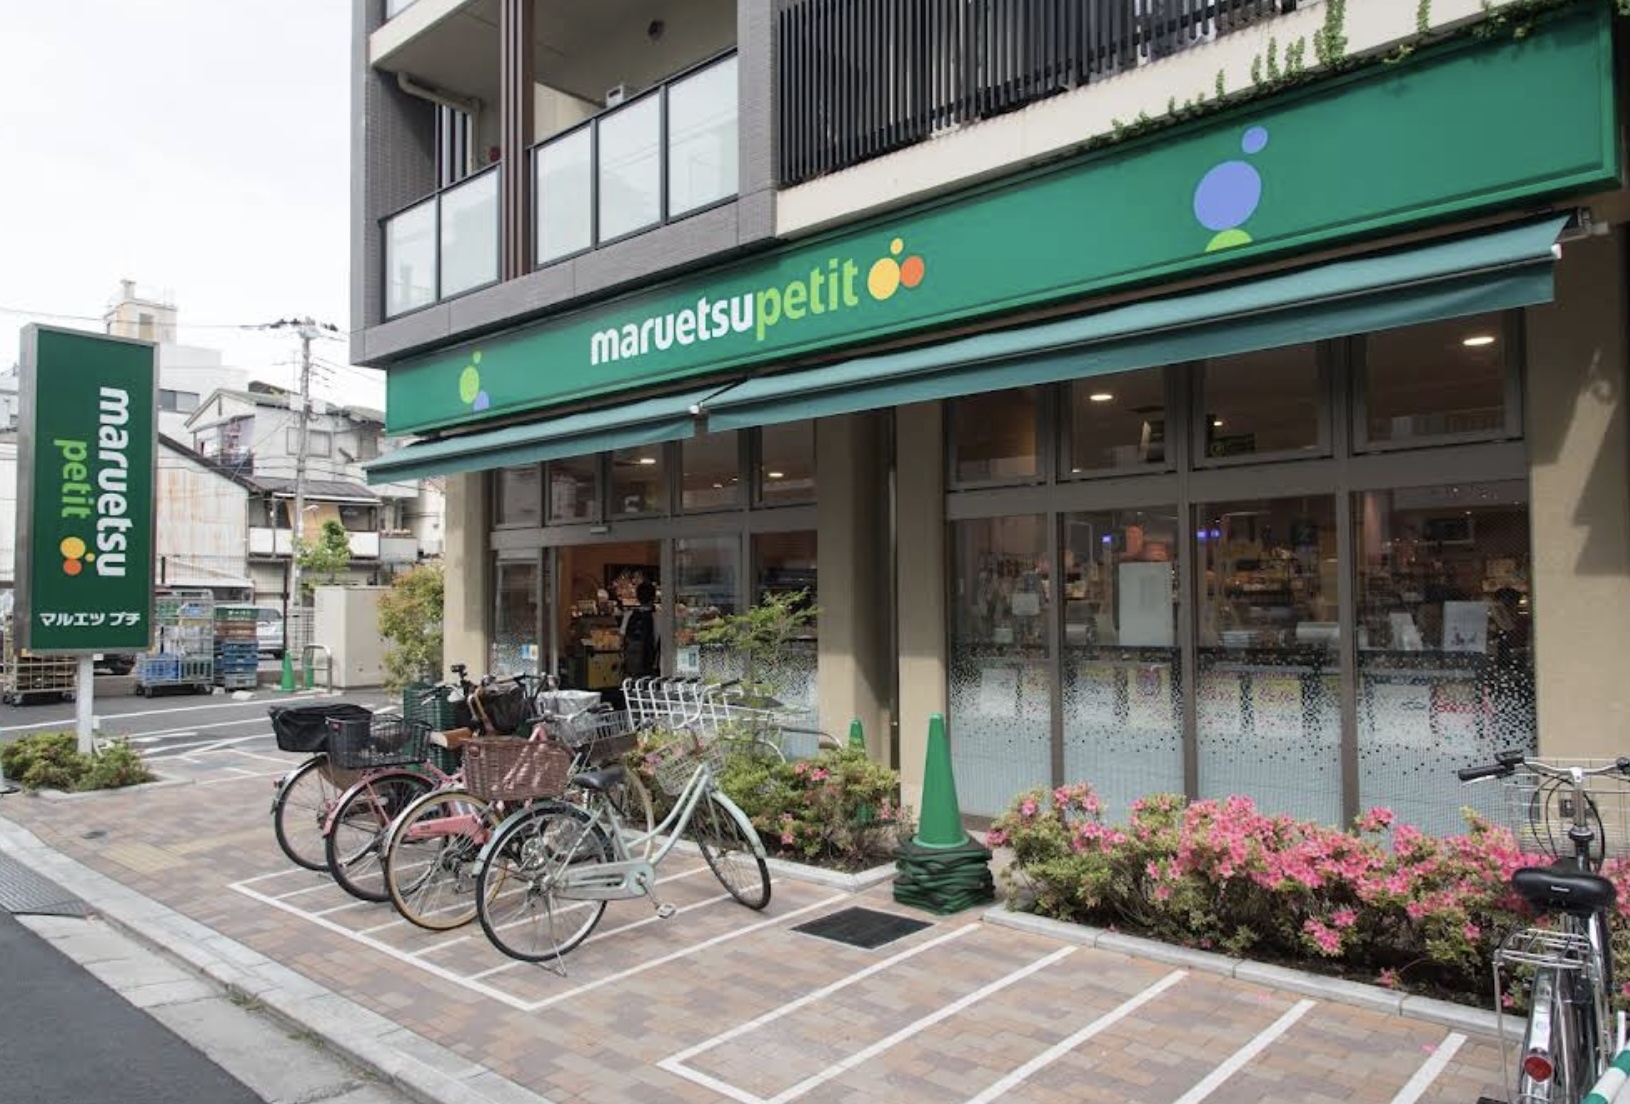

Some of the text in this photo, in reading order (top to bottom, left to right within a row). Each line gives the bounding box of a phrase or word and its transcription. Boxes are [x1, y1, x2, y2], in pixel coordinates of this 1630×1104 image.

[53, 439, 93, 519] petit
[97, 386, 134, 577] maruetsu
[39, 611, 140, 626] マルエツ プチ
